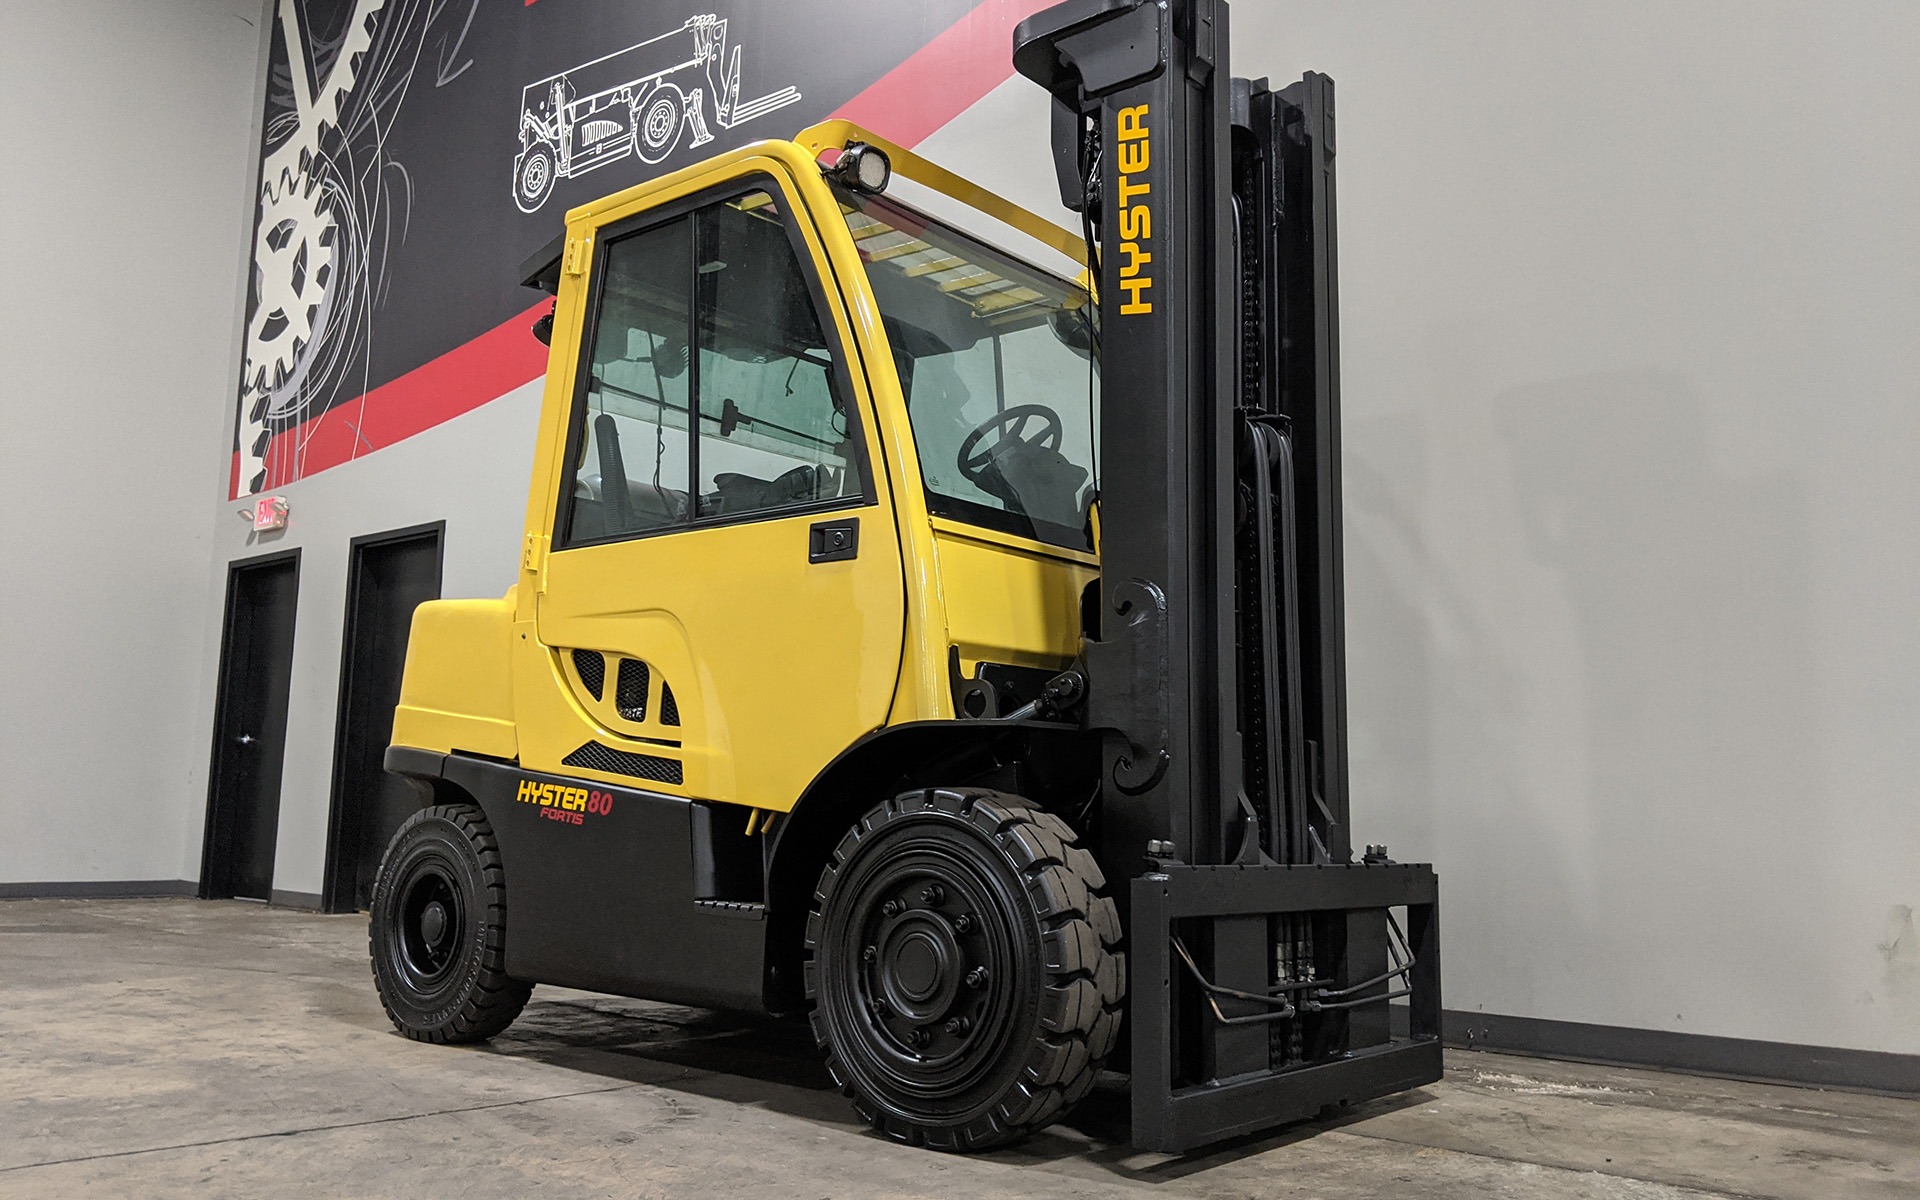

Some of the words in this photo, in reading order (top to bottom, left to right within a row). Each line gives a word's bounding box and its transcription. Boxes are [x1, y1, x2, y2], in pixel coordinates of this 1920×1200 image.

[1117, 103, 1153, 315] HYSTER
[516, 779, 589, 812] HYSTER
[587, 790, 613, 816] 80
[540, 807, 585, 825] FORTIS
